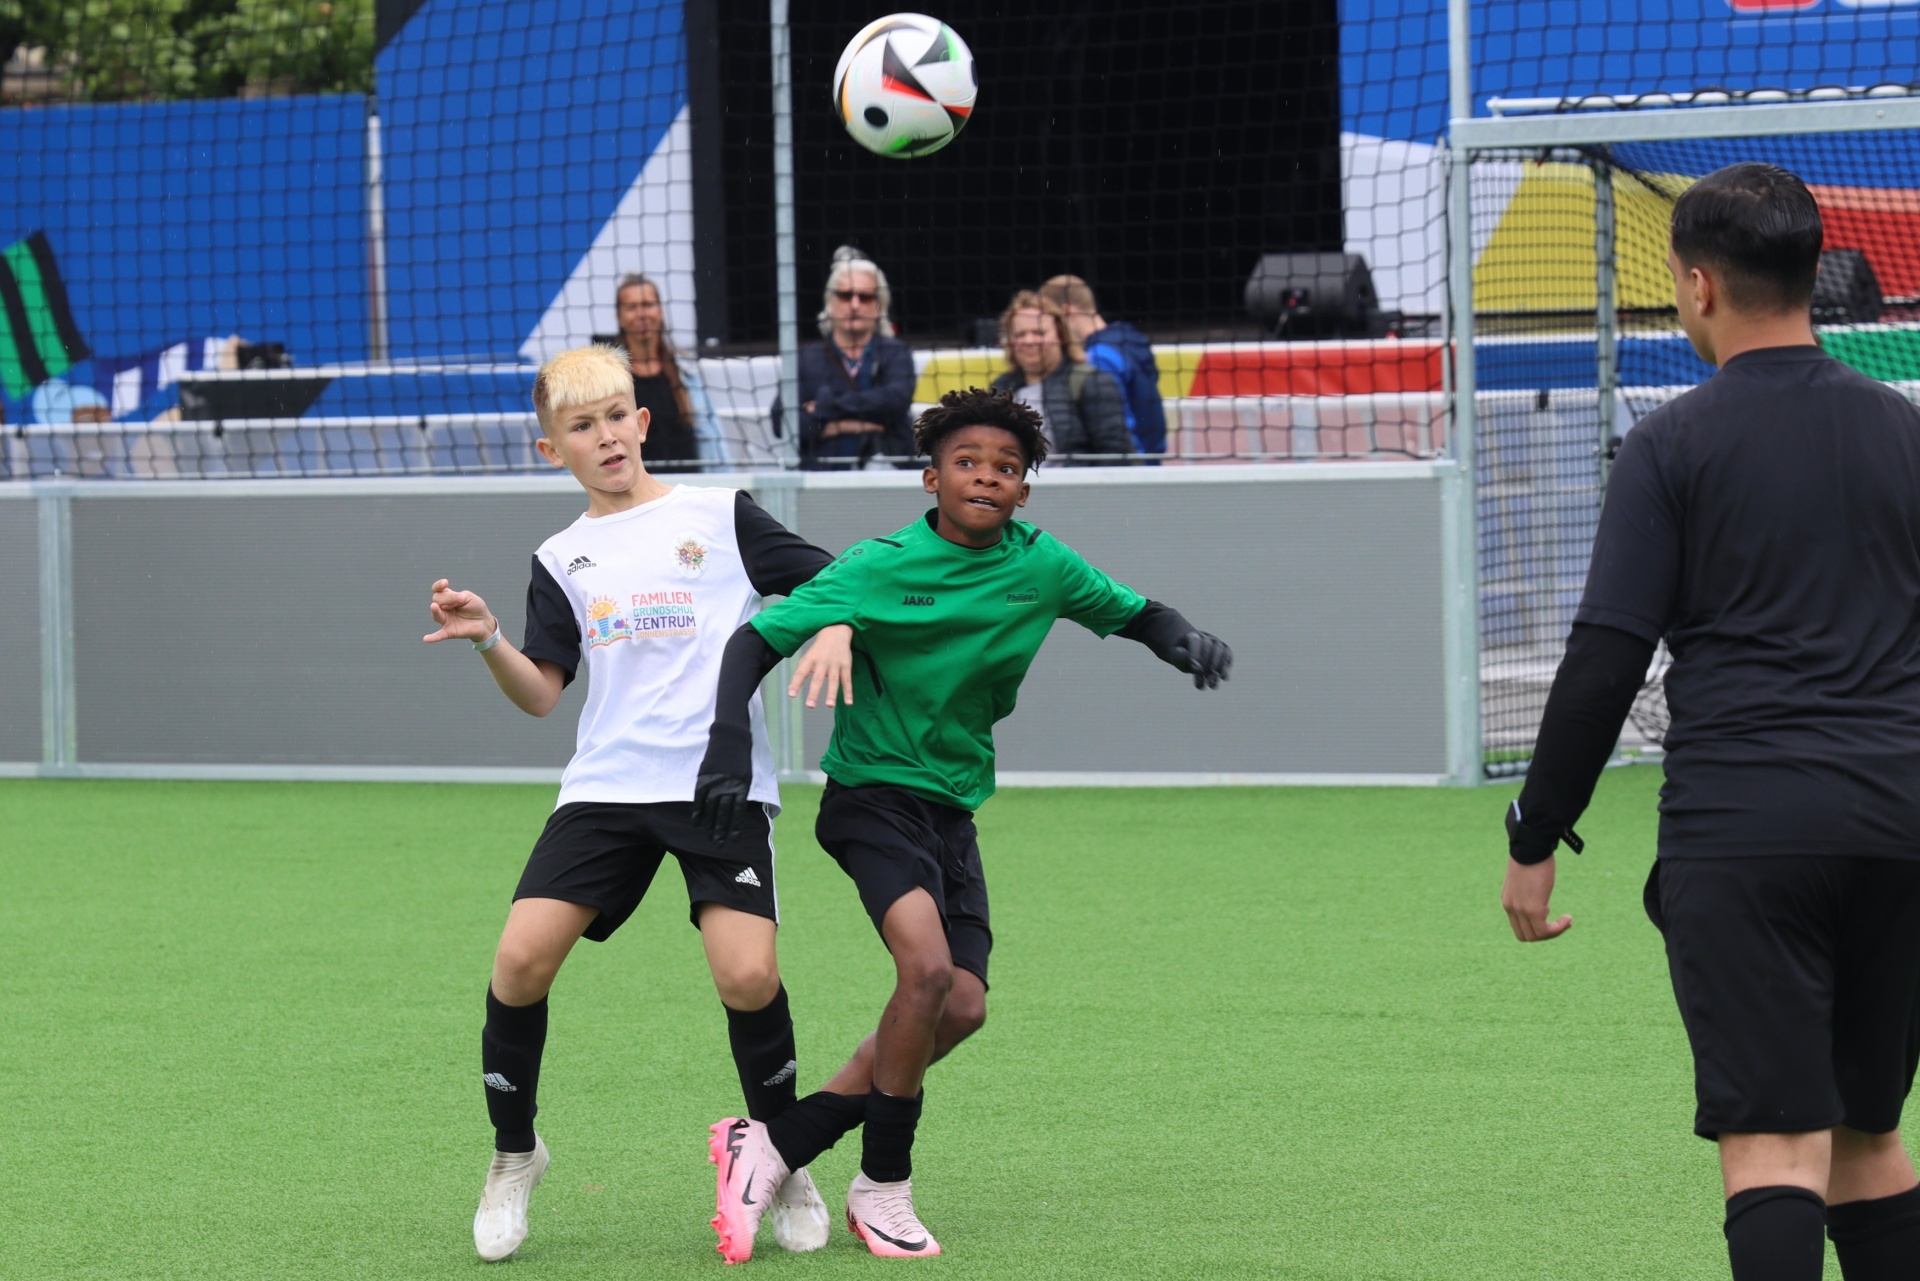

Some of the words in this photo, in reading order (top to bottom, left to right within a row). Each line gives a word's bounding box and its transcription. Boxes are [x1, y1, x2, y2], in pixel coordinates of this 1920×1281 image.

[567, 562, 596, 576] adidas
[631, 591, 692, 607] FAMILIEN
[902, 595, 935, 606] JAKO
[633, 605, 694, 618] GRUNDSCHUL
[634, 615, 696, 631] ZENTRUM
[635, 628, 696, 640] SONNENSTRASSE
[735, 875, 761, 888] adidas
